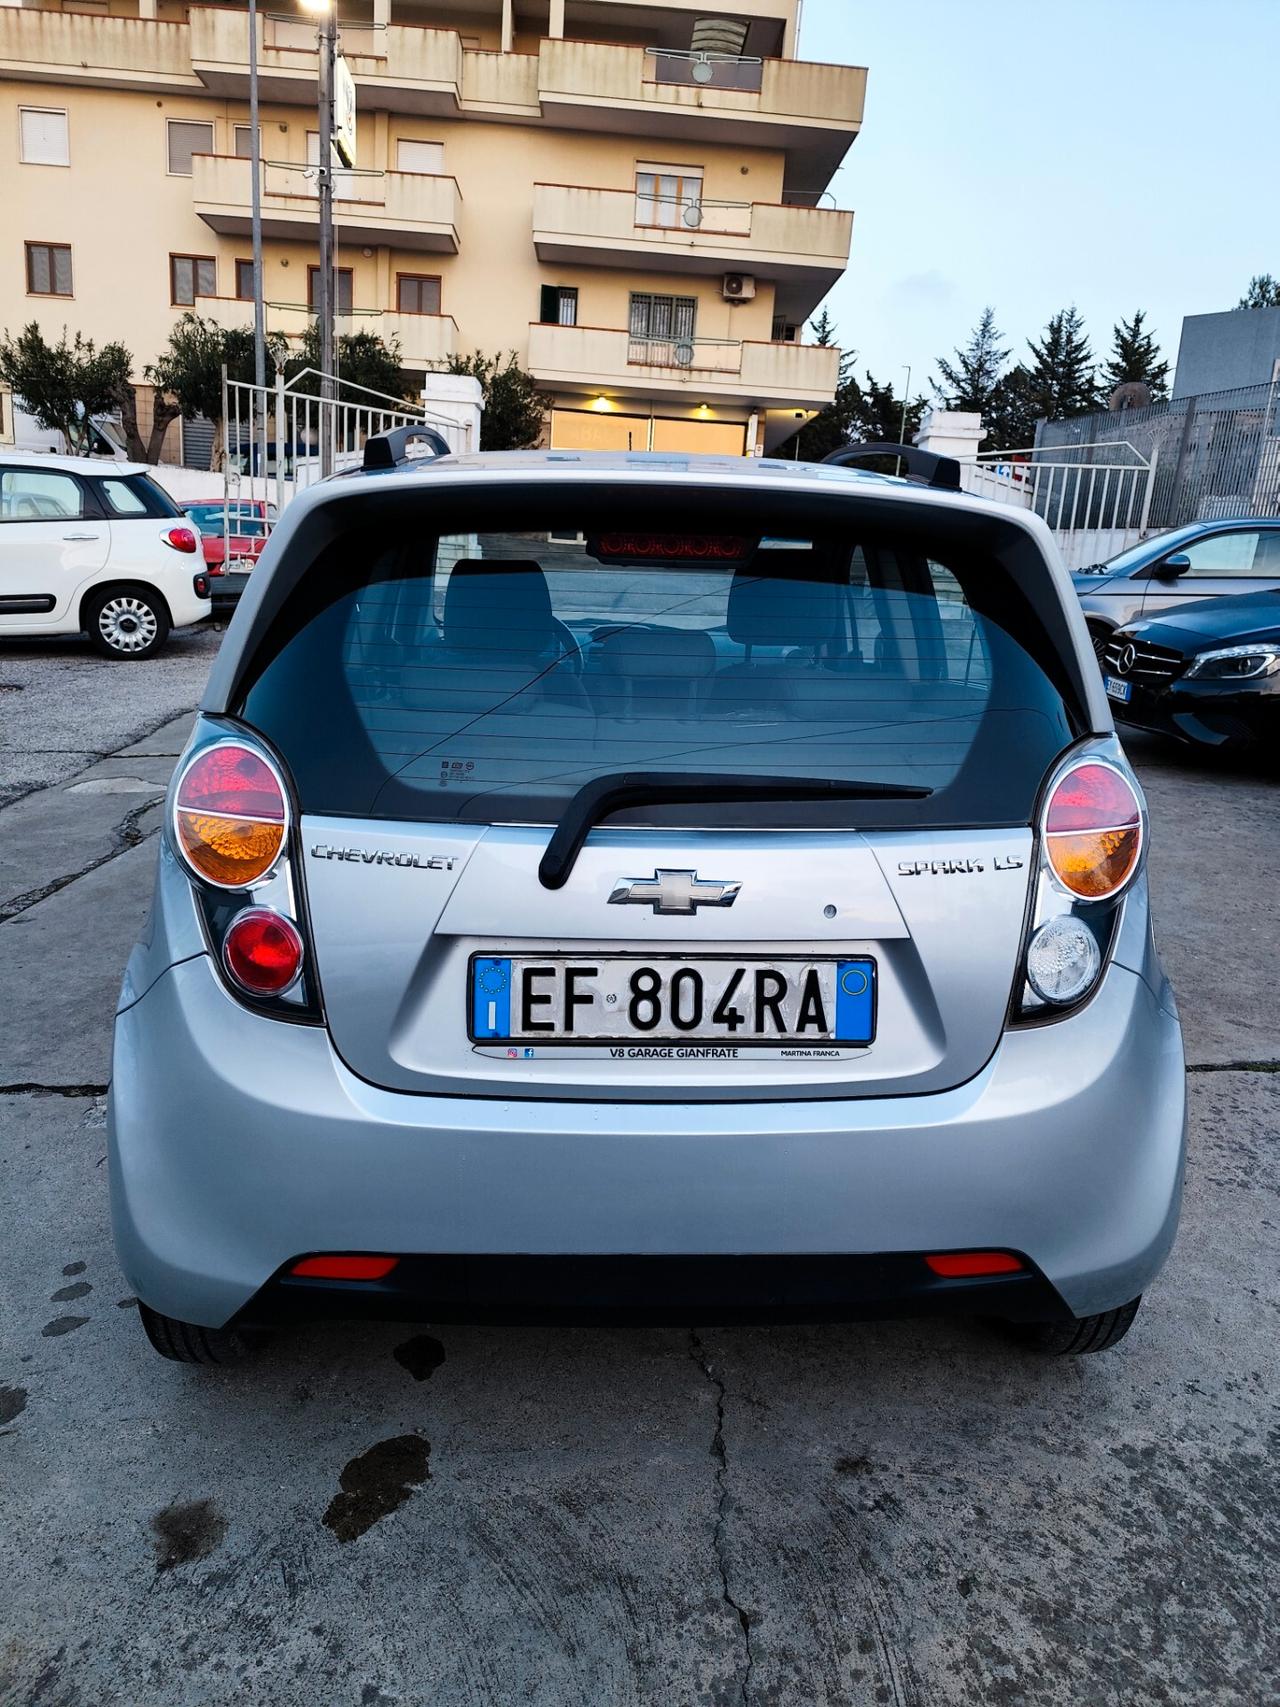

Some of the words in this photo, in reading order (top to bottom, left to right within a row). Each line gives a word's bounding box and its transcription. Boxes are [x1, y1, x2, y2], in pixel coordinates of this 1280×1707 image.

[311, 844, 459, 870] CHEVROLET
[898, 858, 984, 876] SPARK
[993, 855, 1023, 871] LS
[522, 966, 598, 1032] EF
[628, 967, 828, 1033] 804RA
[609, 1048, 625, 1058] V8
[627, 1048, 674, 1058] GARAGE
[676, 1048, 739, 1058] GIANFRATE
